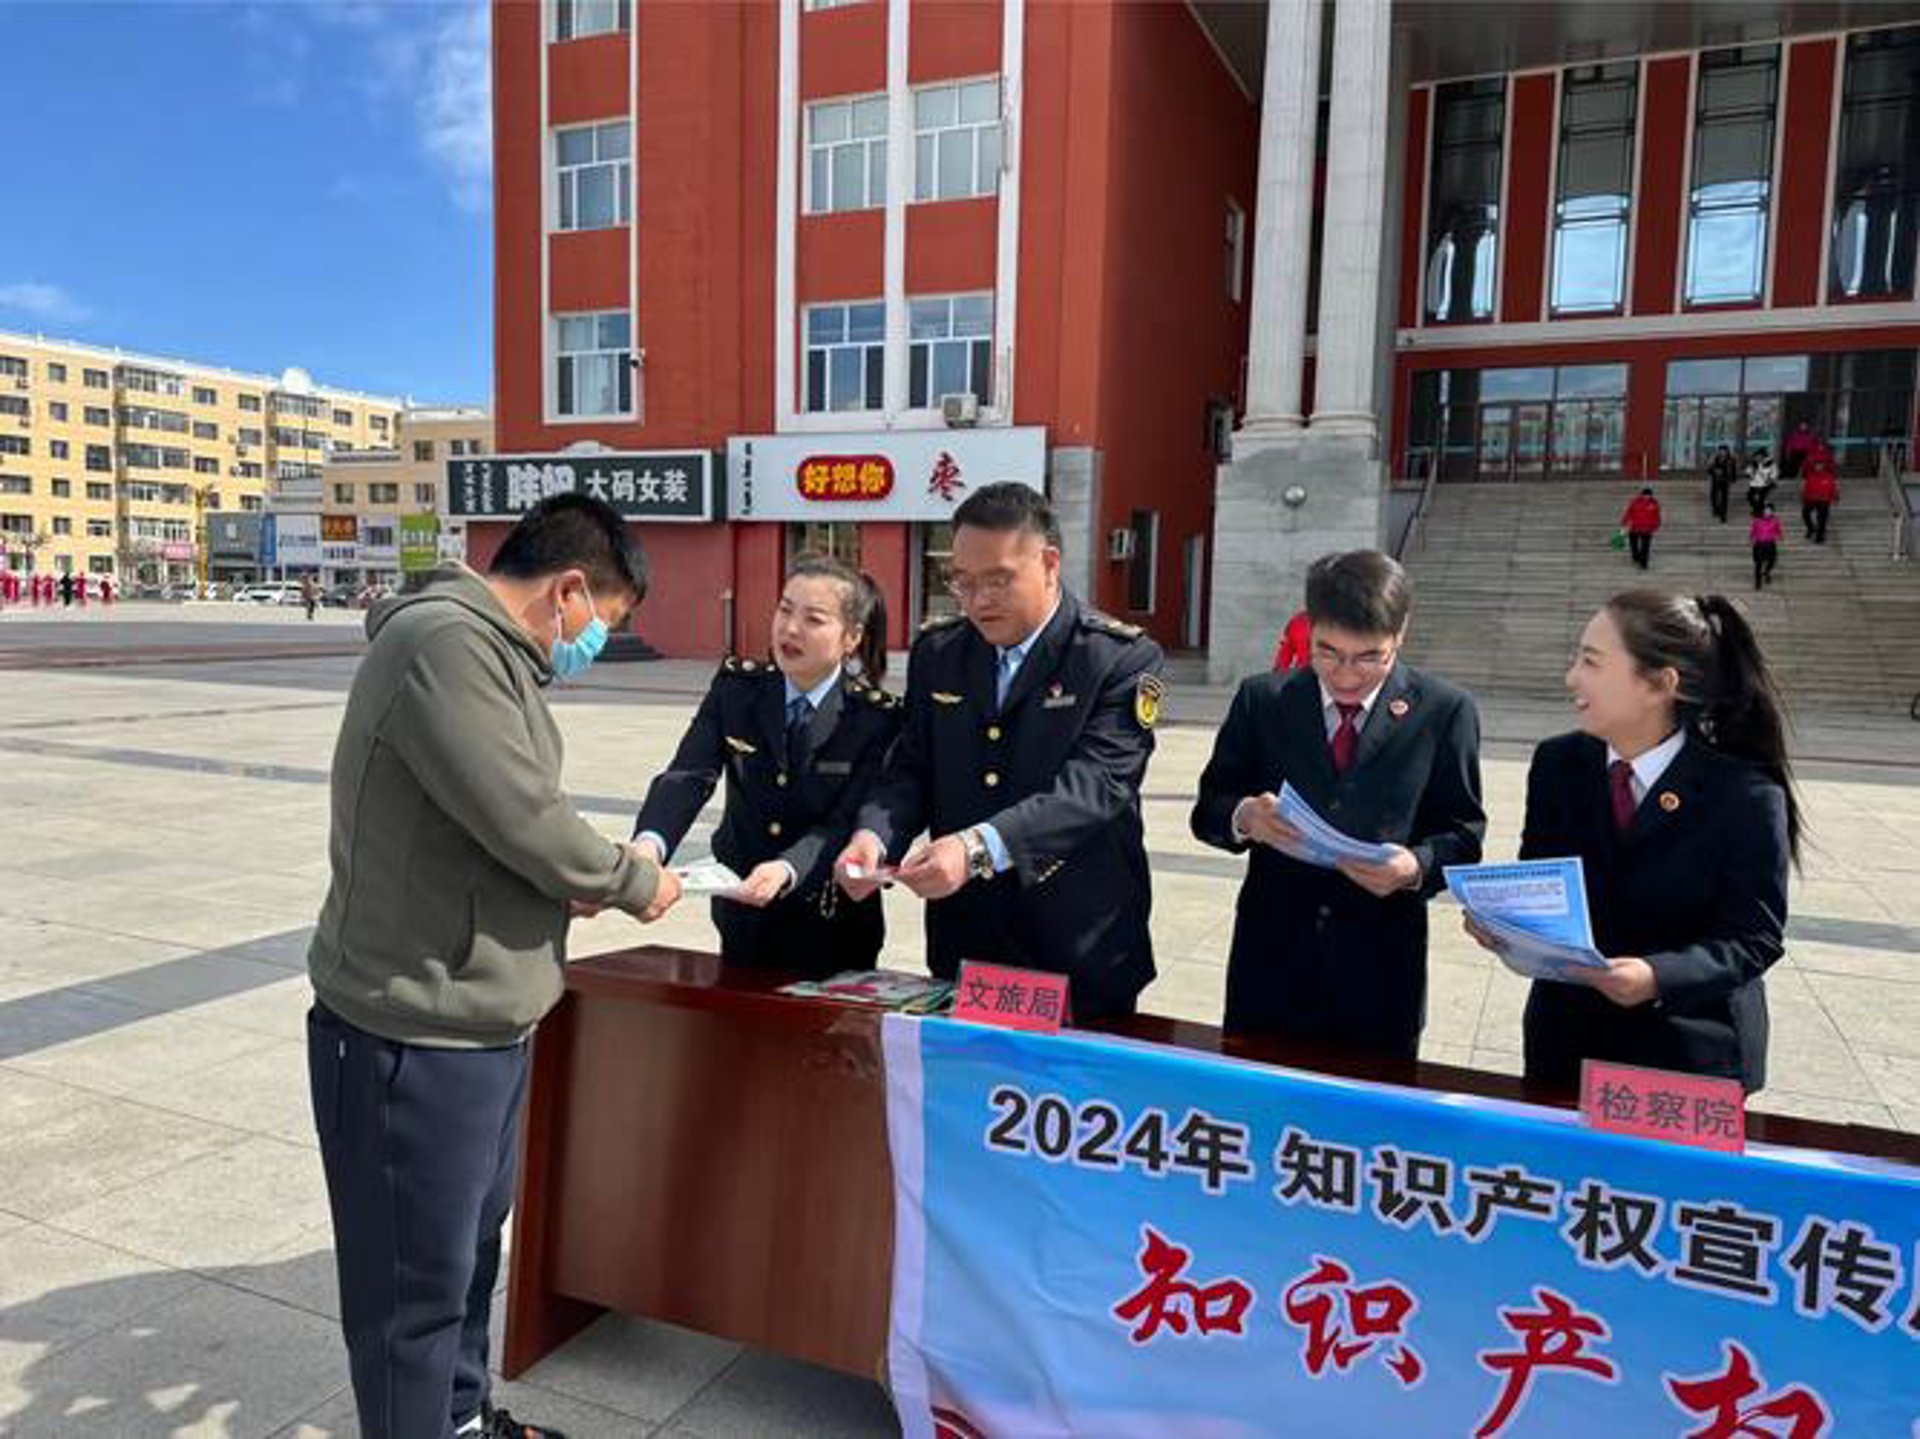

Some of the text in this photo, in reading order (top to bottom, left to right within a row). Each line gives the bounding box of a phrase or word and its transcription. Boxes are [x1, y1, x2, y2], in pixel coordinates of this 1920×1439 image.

[585, 468, 689, 502] 大码女装
[803, 451, 966, 501] 好想你 枣
[962, 976, 1061, 1021] 文旅局
[1597, 1080, 1742, 1141] 检察院
[988, 1089, 1920, 1328] 2024年 知识产权宣传
